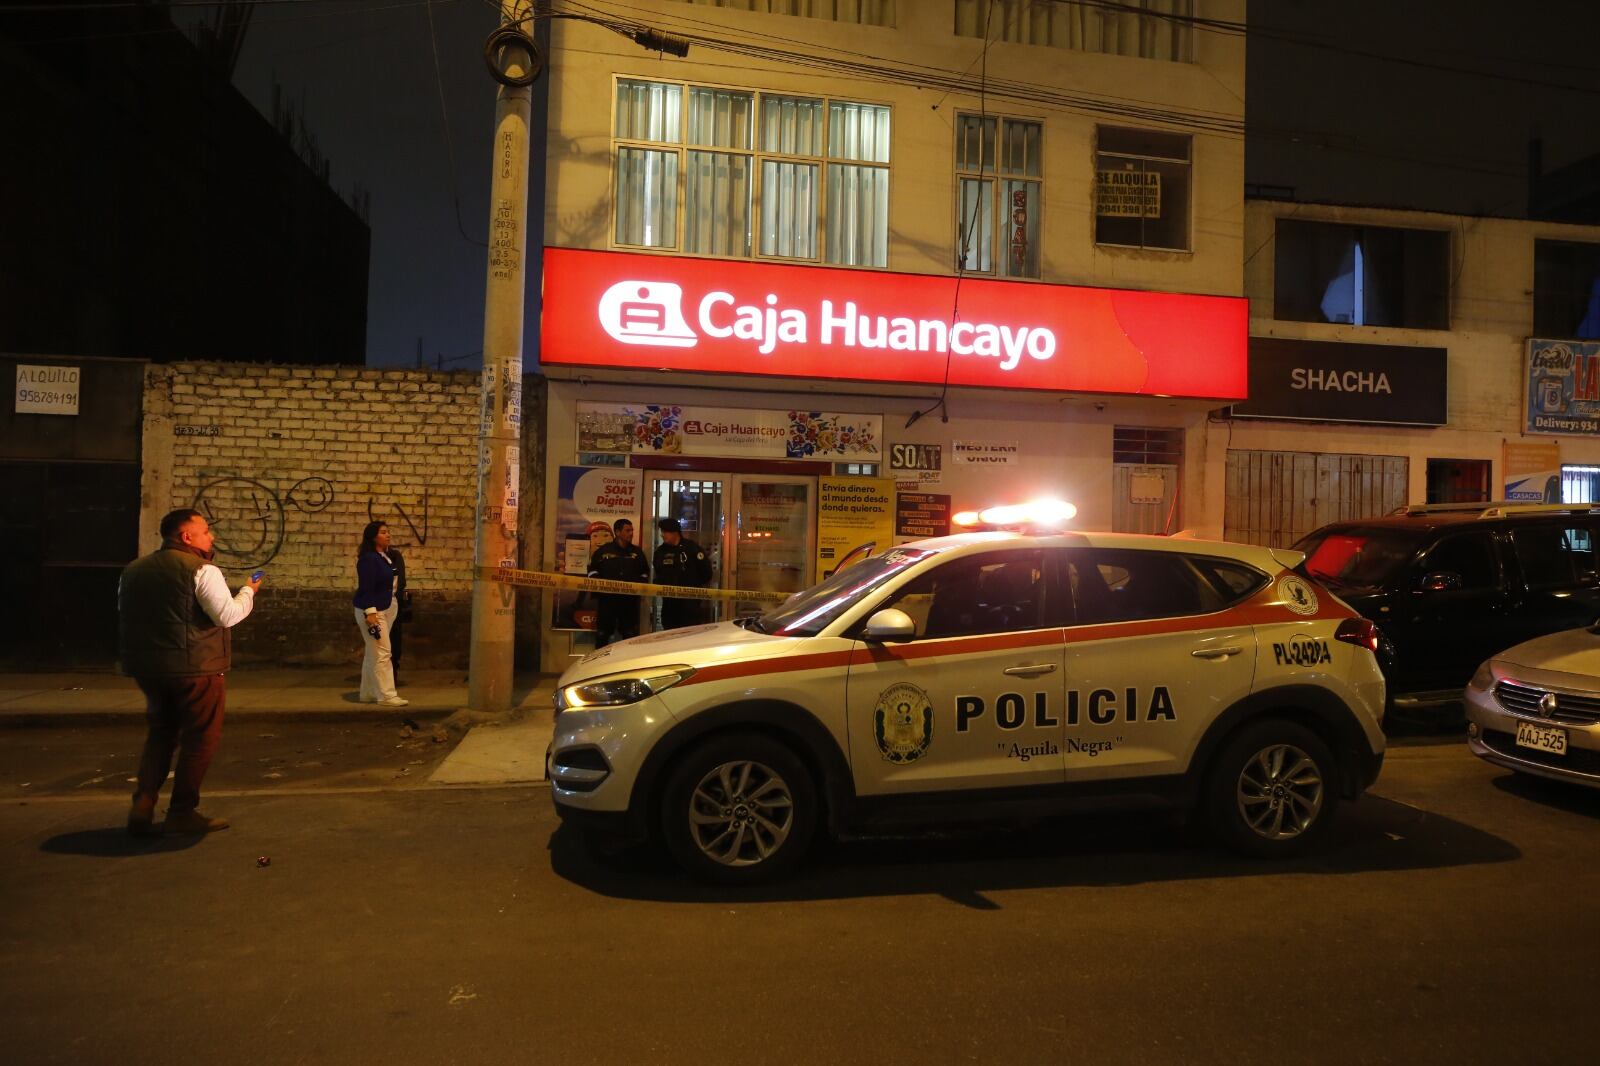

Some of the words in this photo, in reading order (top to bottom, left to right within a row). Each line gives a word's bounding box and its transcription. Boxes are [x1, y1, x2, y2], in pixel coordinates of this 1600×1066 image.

[1096, 173, 1110, 184] SE
[1112, 173, 1158, 186] ALQUILA
[698, 290, 807, 354] Caja
[820, 299, 1056, 370] Huancayo
[19, 368, 78, 384] ALQUILO
[1290, 367, 1392, 394] SHACHA
[704, 422, 729, 436] Caja
[730, 424, 786, 438] Huancayo
[1536, 417, 1578, 431] Delivery:
[1581, 421, 1598, 431] 934
[892, 444, 941, 469] SOAT
[604, 485, 636, 495] SOAT
[848, 484, 876, 493] dinero
[596, 495, 635, 508] Digital
[822, 494, 830, 502] al
[832, 494, 862, 502] mundo
[864, 495, 889, 503] desde
[822, 504, 848, 512] donde
[955, 686, 1177, 732] POLICIA
[1518, 728, 1565, 750] AAJ-525
[998, 740, 1059, 762] "Aguila
[1066, 735, 1123, 757] Negra"
